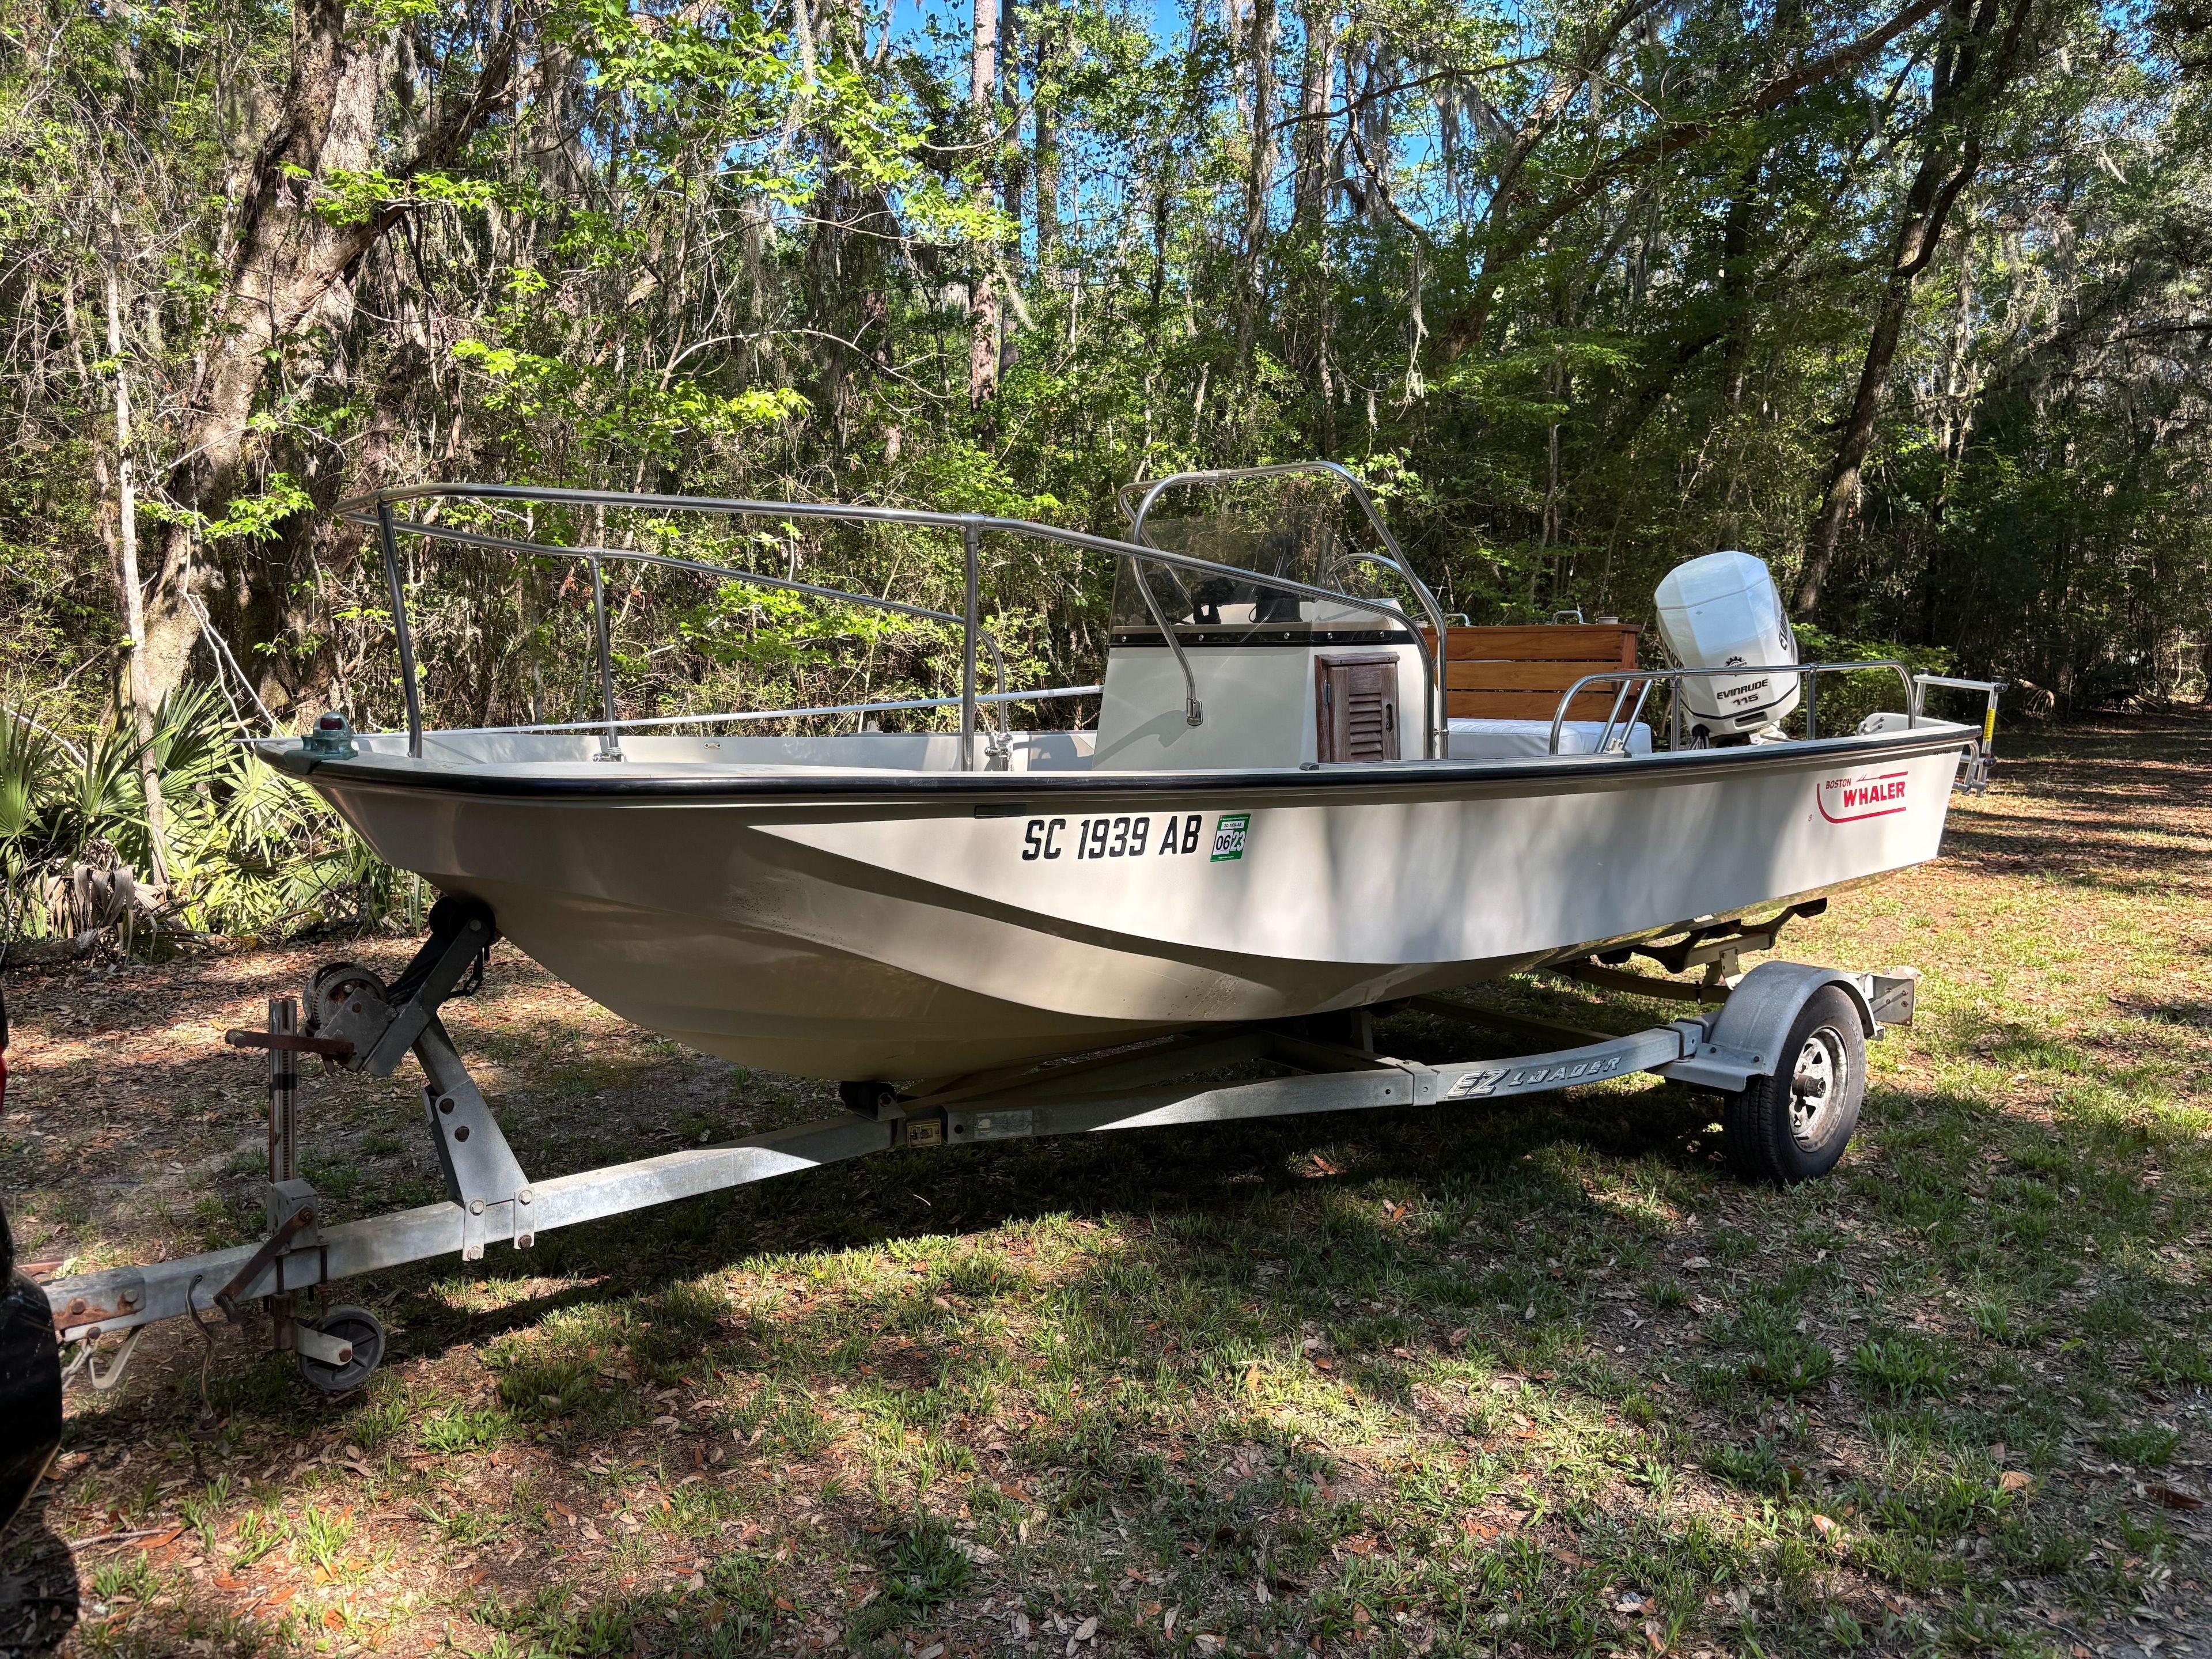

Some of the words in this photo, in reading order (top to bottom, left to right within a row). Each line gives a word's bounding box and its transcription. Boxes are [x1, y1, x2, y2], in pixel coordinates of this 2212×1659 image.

[1717, 679, 1768, 700] EVINRUDE
[1732, 693, 1759, 706] 115
[1825, 778, 1851, 790] BOSTON
[1843, 781, 1906, 808] WHALER
[1022, 818, 1066, 861] SC
[1077, 817, 1150, 860] 1939
[1158, 815, 1202, 855] AB
[1215, 835, 1231, 851] 06
[1229, 831, 1246, 851] 23
[1443, 1068, 1510, 1099] EZ
